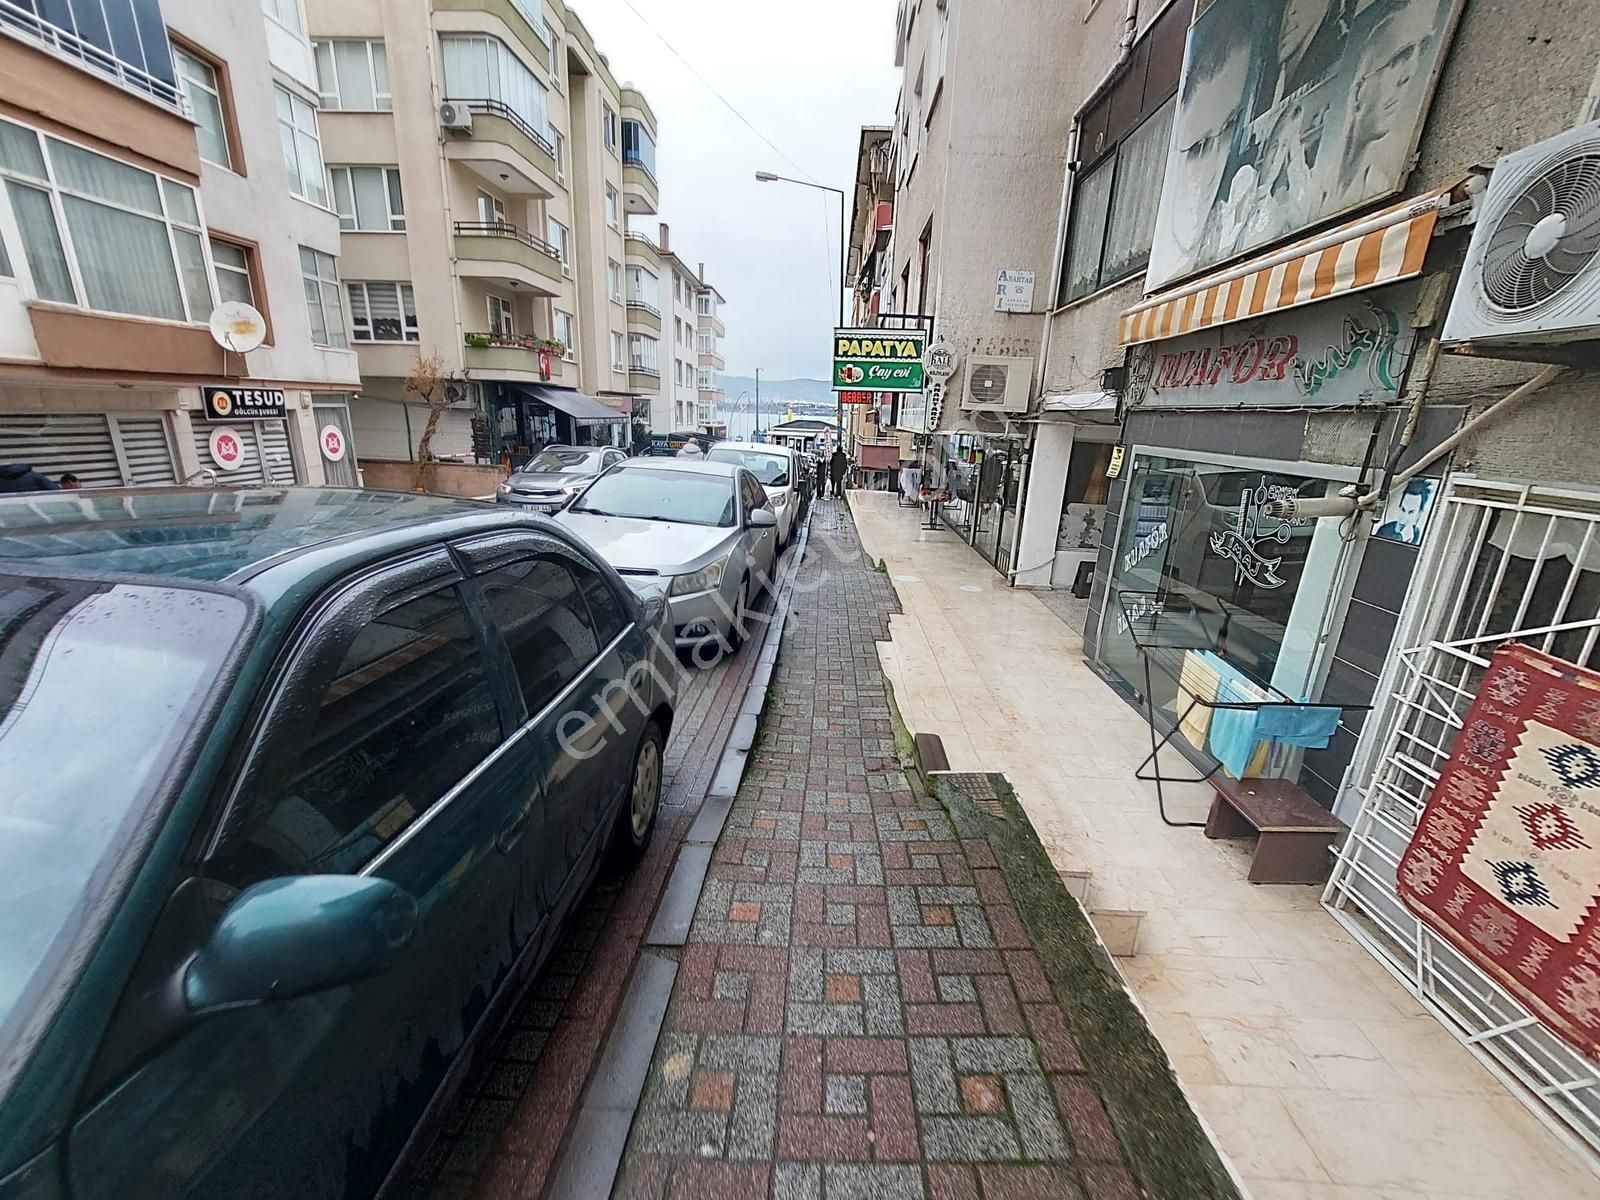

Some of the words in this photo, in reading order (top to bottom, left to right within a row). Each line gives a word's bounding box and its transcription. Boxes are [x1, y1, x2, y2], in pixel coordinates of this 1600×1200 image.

[838, 339, 917, 357] PAPATYA
[868, 365, 892, 380] Çay
[893, 366, 912, 378] evi
[232, 390, 284, 406] TESUD
[841, 392, 872, 403] BERBER
[234, 407, 259, 416] GÖLCÜK
[651, 440, 669, 448] KAYA
[1124, 522, 1168, 573] KUAFÖR
